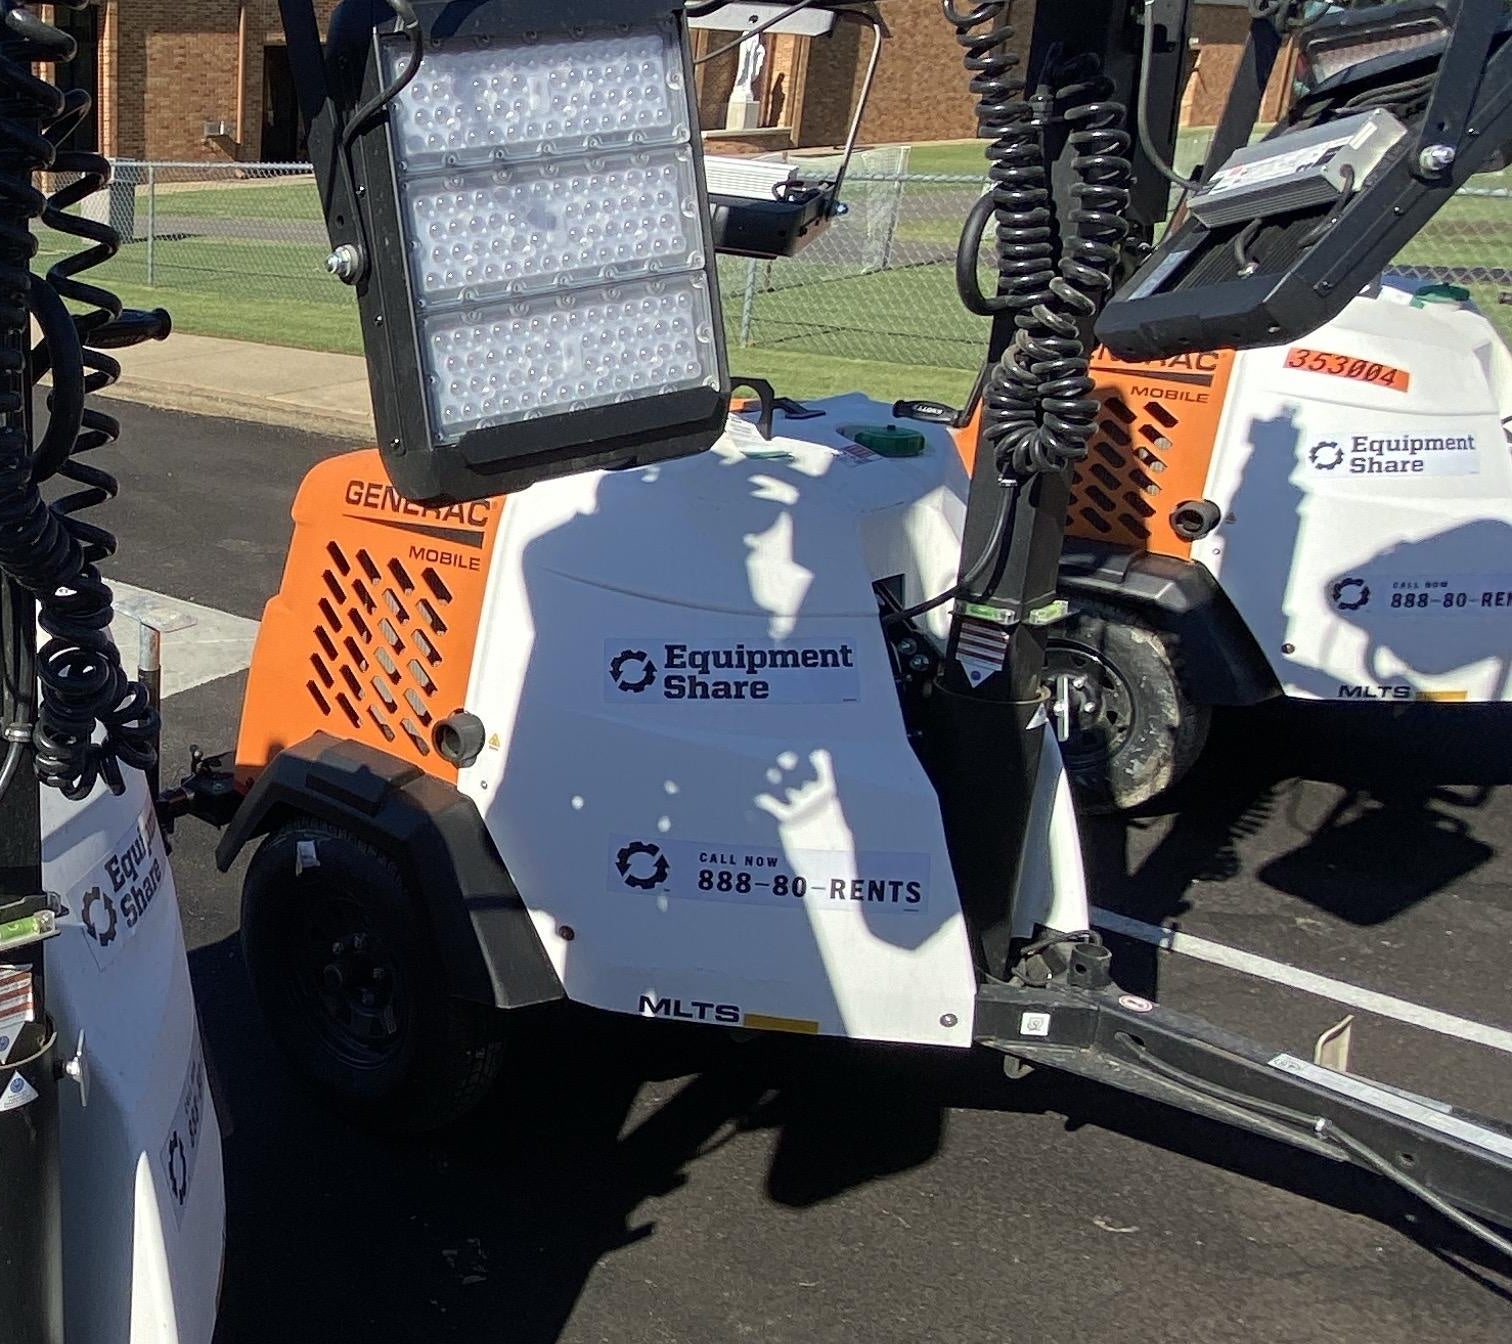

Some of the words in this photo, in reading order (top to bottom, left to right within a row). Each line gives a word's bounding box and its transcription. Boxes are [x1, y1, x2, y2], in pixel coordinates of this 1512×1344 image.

[1130, 385, 1210, 404] MOBILE
[1350, 434, 1475, 457] Equipment
[1349, 457, 1425, 474] Share
[408, 545, 481, 571] MOBILE
[664, 644, 854, 674] Equipment
[663, 675, 769, 700] Share
[1338, 685, 1411, 699] MLTS
[699, 852, 737, 866] CALL
[744, 855, 779, 868] NOW
[120, 857, 163, 929] Share
[697, 869, 922, 904] 888-80-RENTS
[638, 994, 741, 1023] MLTS
